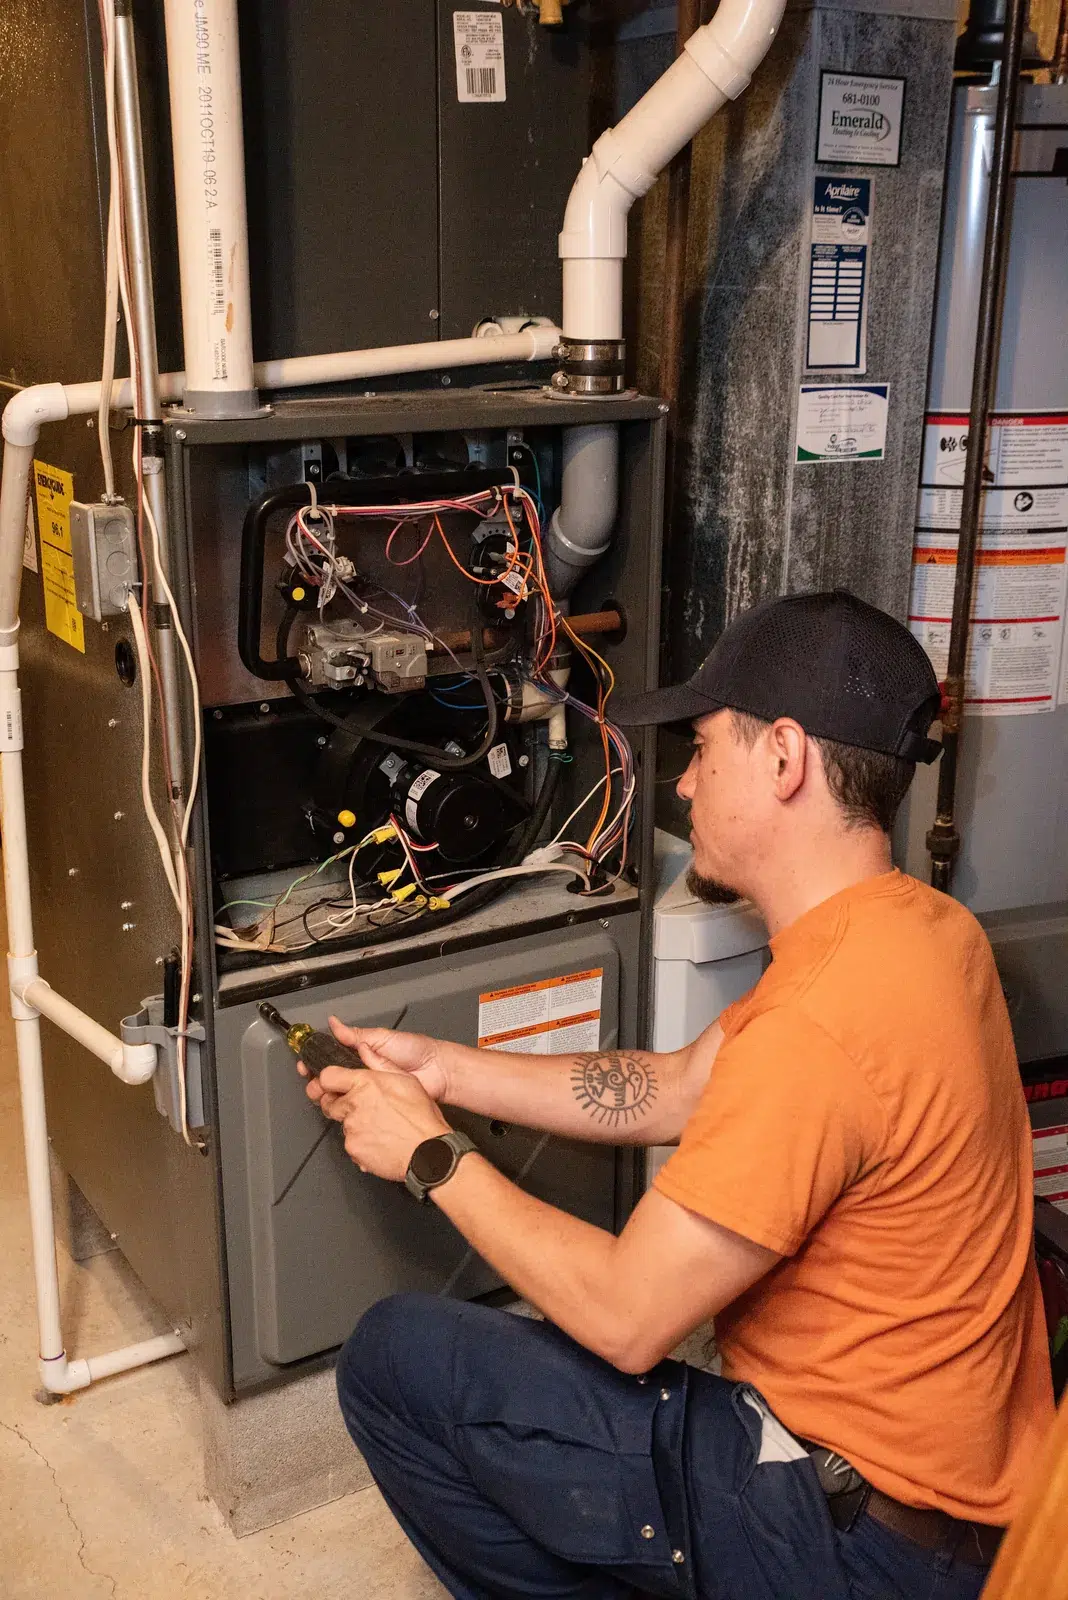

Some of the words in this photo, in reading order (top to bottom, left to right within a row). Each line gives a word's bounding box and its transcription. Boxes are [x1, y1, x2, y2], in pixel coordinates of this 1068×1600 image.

[197, 53, 211, 75] ME
[849, 80, 878, 91] Emergency
[842, 92, 880, 106] 681-0100
[831, 110, 884, 130] Emerald
[832, 128, 853, 138] Heating
[859, 129, 880, 140] Cooling
[824, 183, 861, 199] Aprilaire
[991, 418, 1025, 426] DANGER
